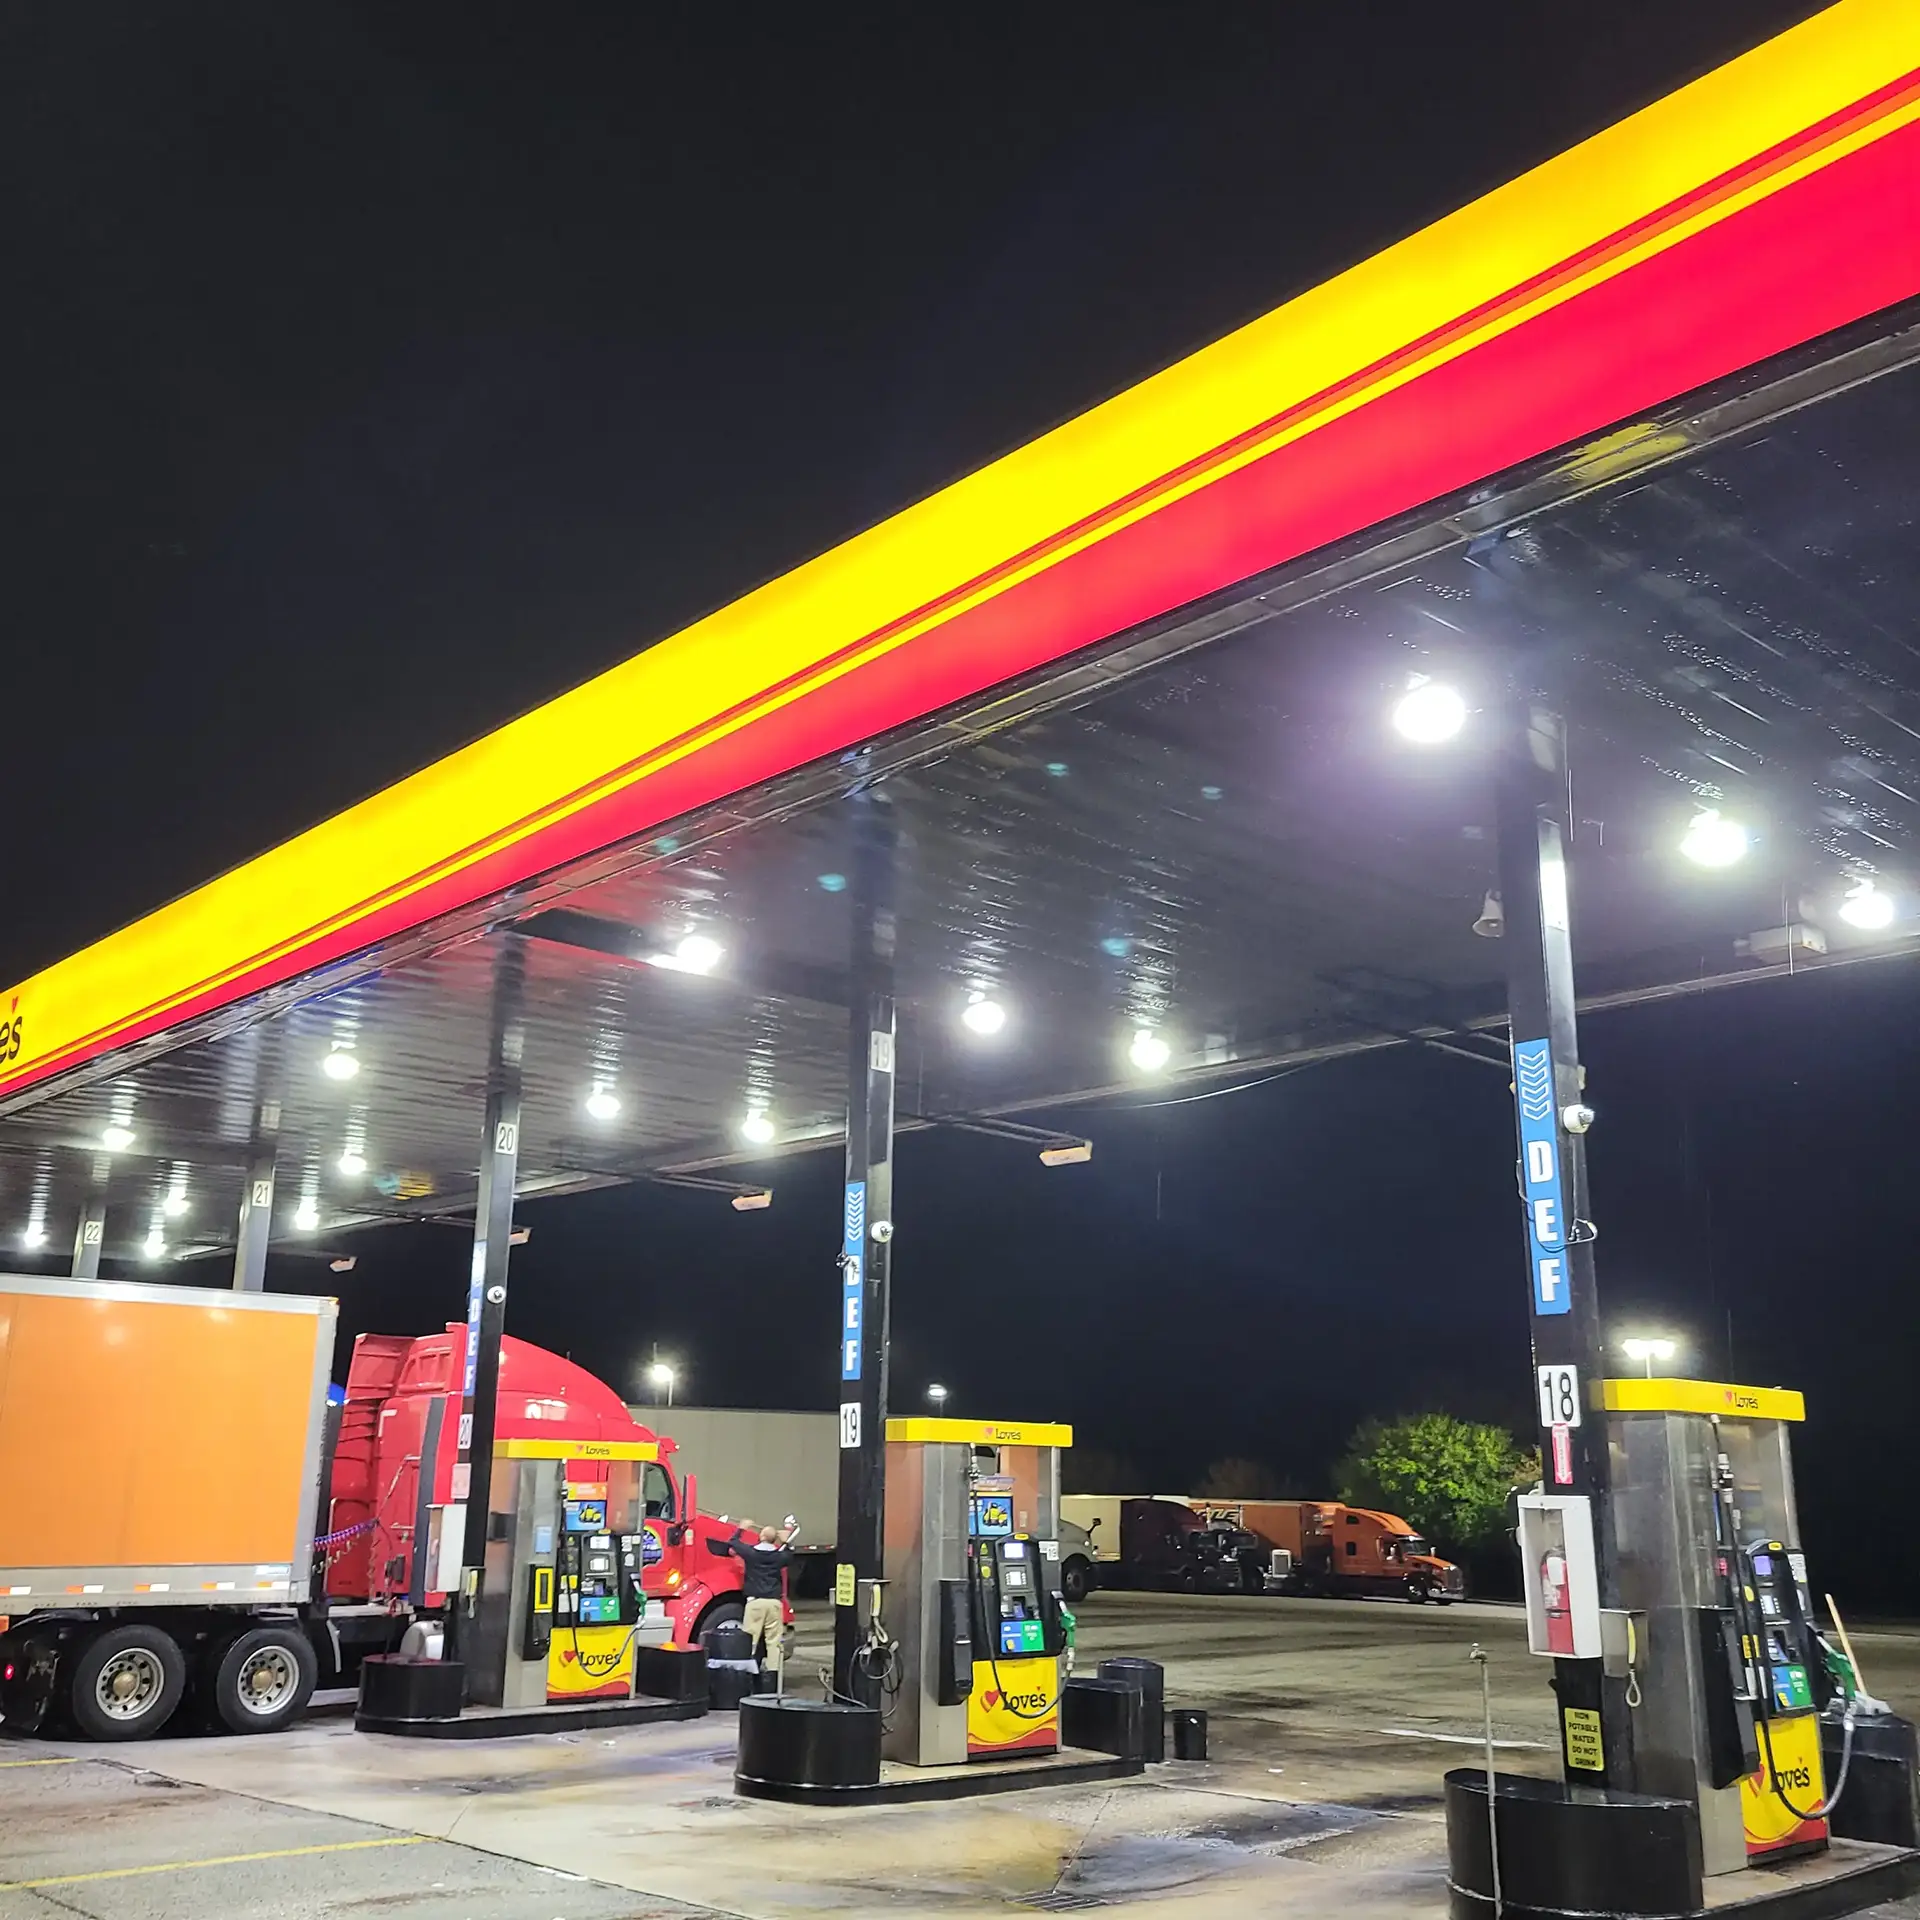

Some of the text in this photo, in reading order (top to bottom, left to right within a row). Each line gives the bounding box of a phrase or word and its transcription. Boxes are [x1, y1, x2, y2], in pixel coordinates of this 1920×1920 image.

[497, 1126, 514, 1152] 20
[255, 1184, 269, 1204] 21
[86, 1224, 100, 1241] 22
[1543, 1371, 1574, 1422] 18
[843, 1407, 858, 1444] 19
